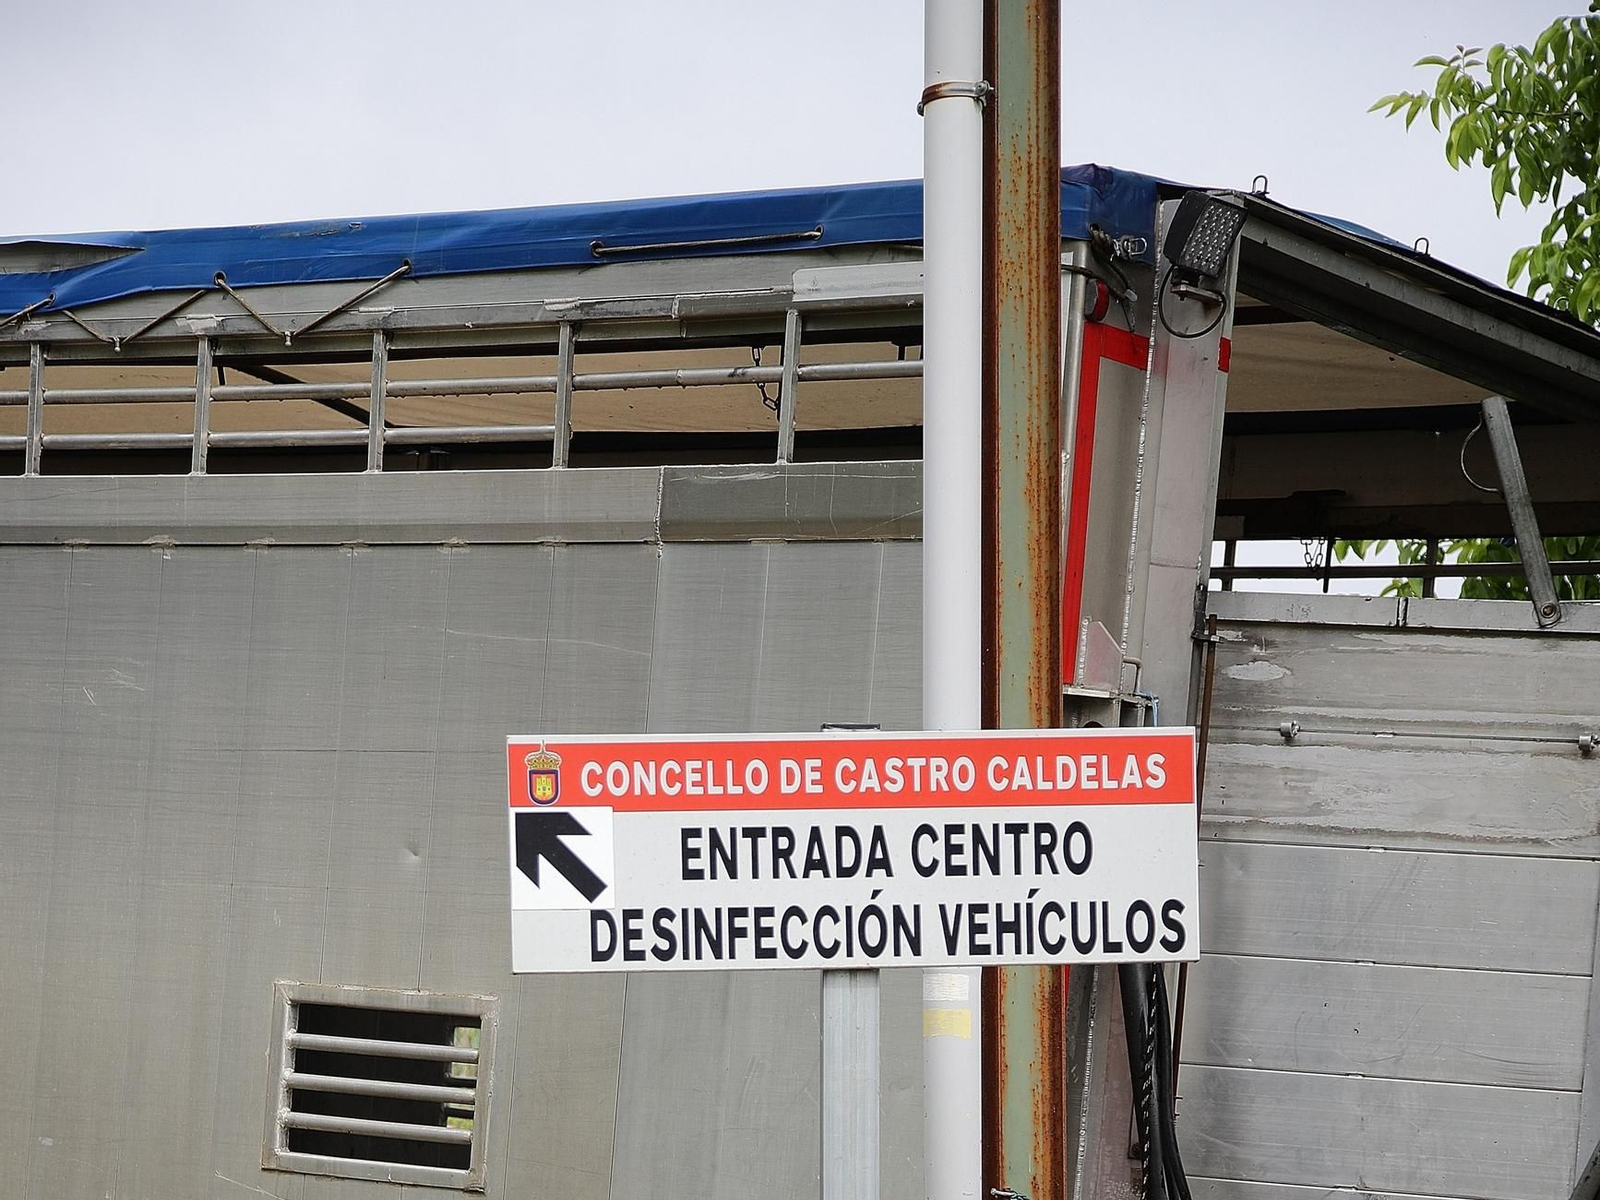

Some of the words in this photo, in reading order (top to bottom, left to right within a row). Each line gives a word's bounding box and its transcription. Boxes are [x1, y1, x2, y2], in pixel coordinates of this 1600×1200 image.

[580, 758, 770, 797] CONCELLO
[779, 758, 824, 794] DE
[835, 756, 976, 794] CASTRO
[986, 753, 1167, 792] CALDELAS
[680, 825, 894, 881] ENTRADA
[911, 821, 1093, 878] CENTRO
[589, 890, 923, 963] DESINFECCIÓN
[938, 888, 1187, 957] VEHÍCULOS
